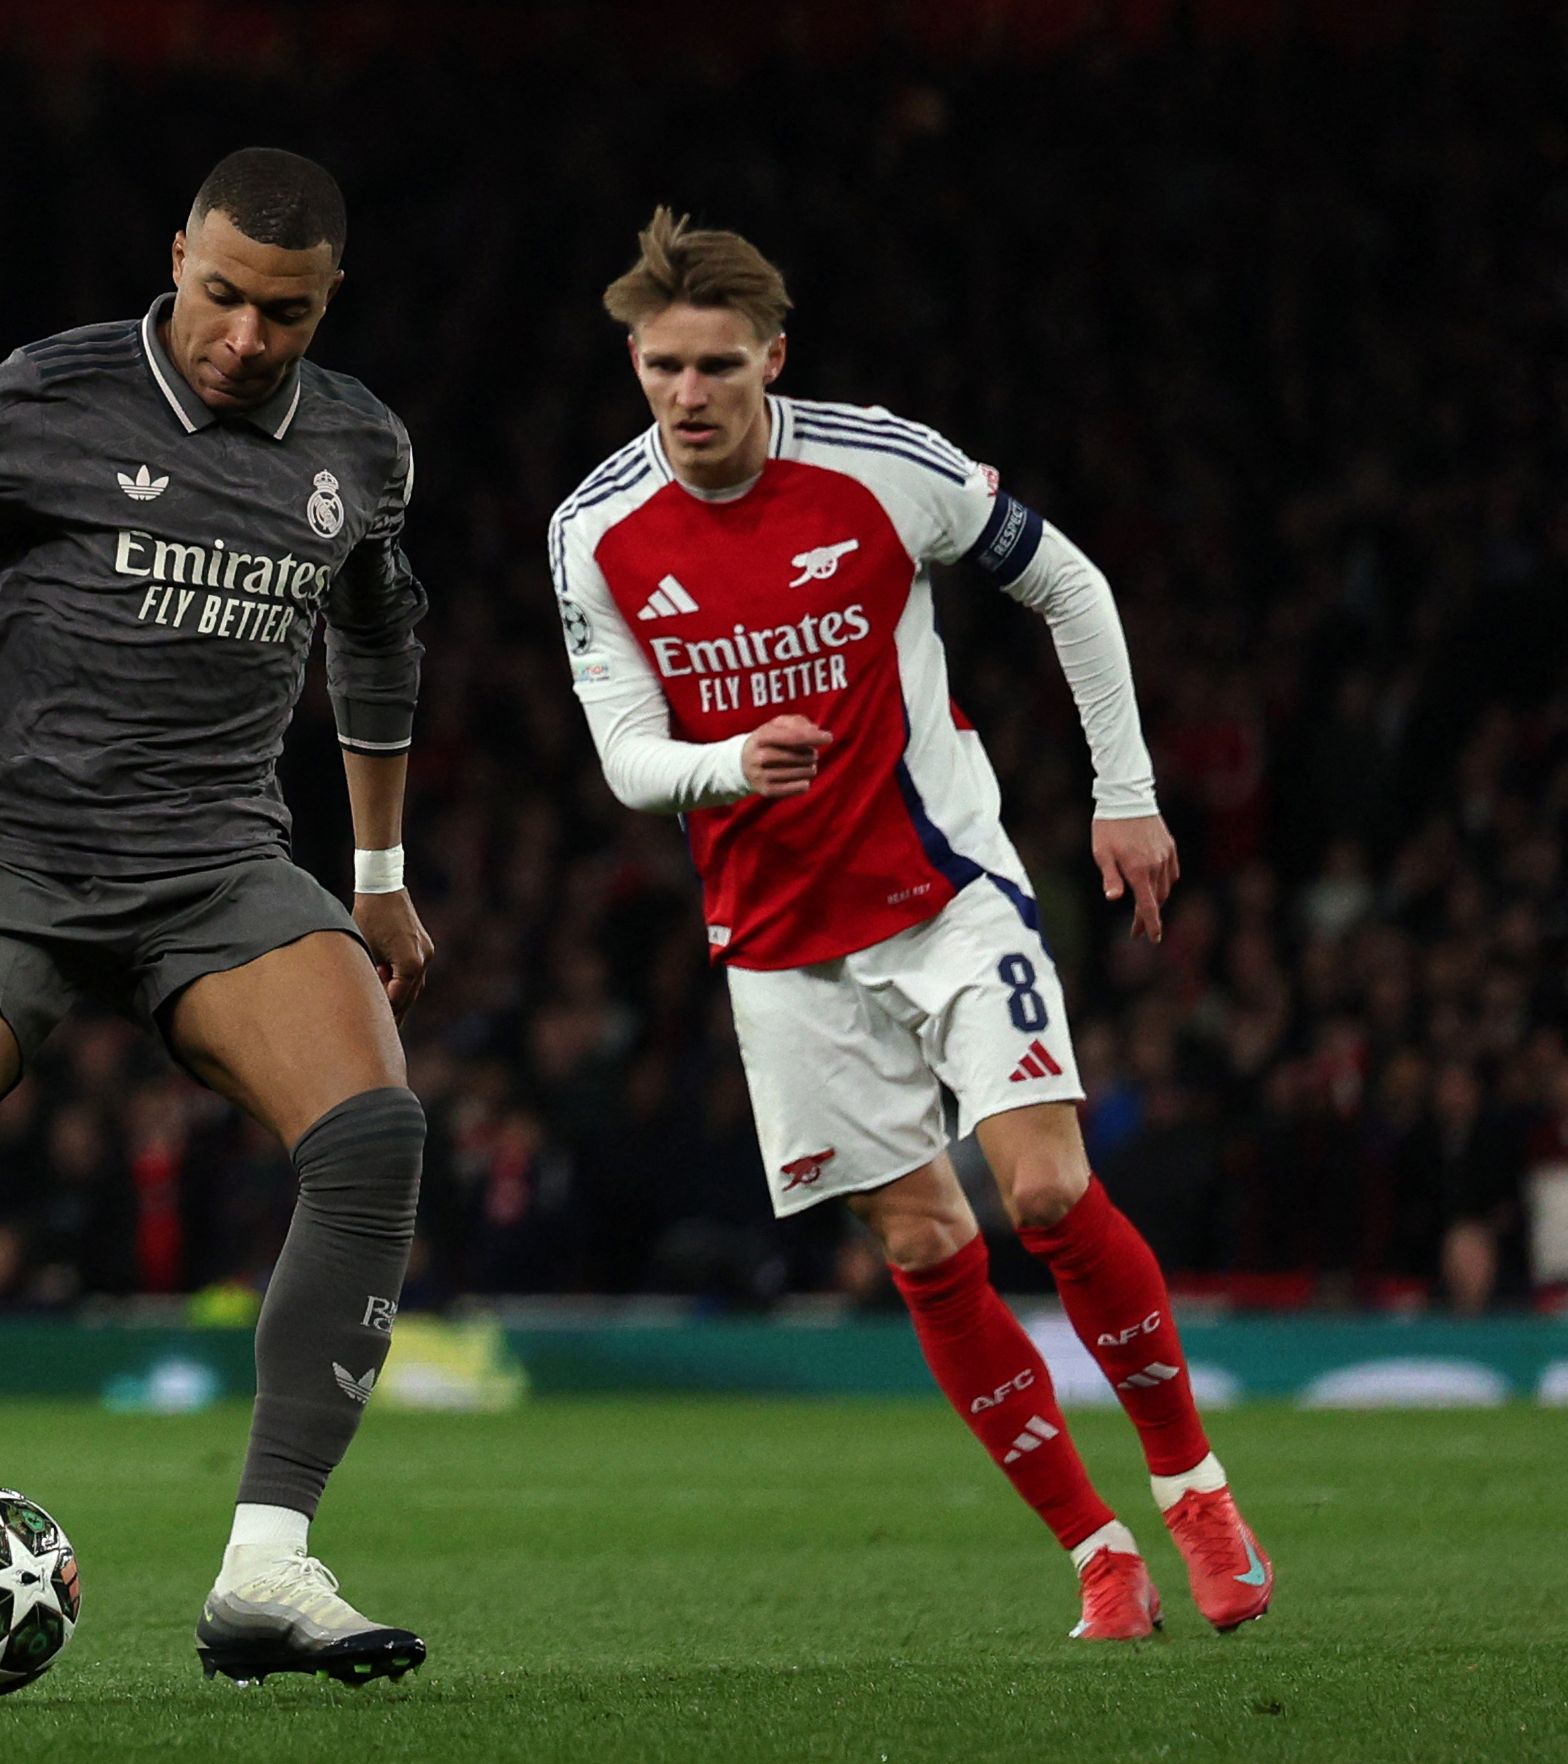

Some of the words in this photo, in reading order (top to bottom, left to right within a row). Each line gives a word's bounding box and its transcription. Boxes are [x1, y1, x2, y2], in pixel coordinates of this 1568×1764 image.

[115, 530, 331, 600] Emirates
[138, 586, 195, 628] FLY
[198, 594, 295, 643] BETTER
[649, 604, 871, 678] Emirates
[699, 674, 740, 713] FLY
[750, 654, 848, 708] BETTER
[997, 952, 1049, 1034] 8
[1096, 1311, 1161, 1346] AFC
[970, 1368, 1035, 1414] AFC
